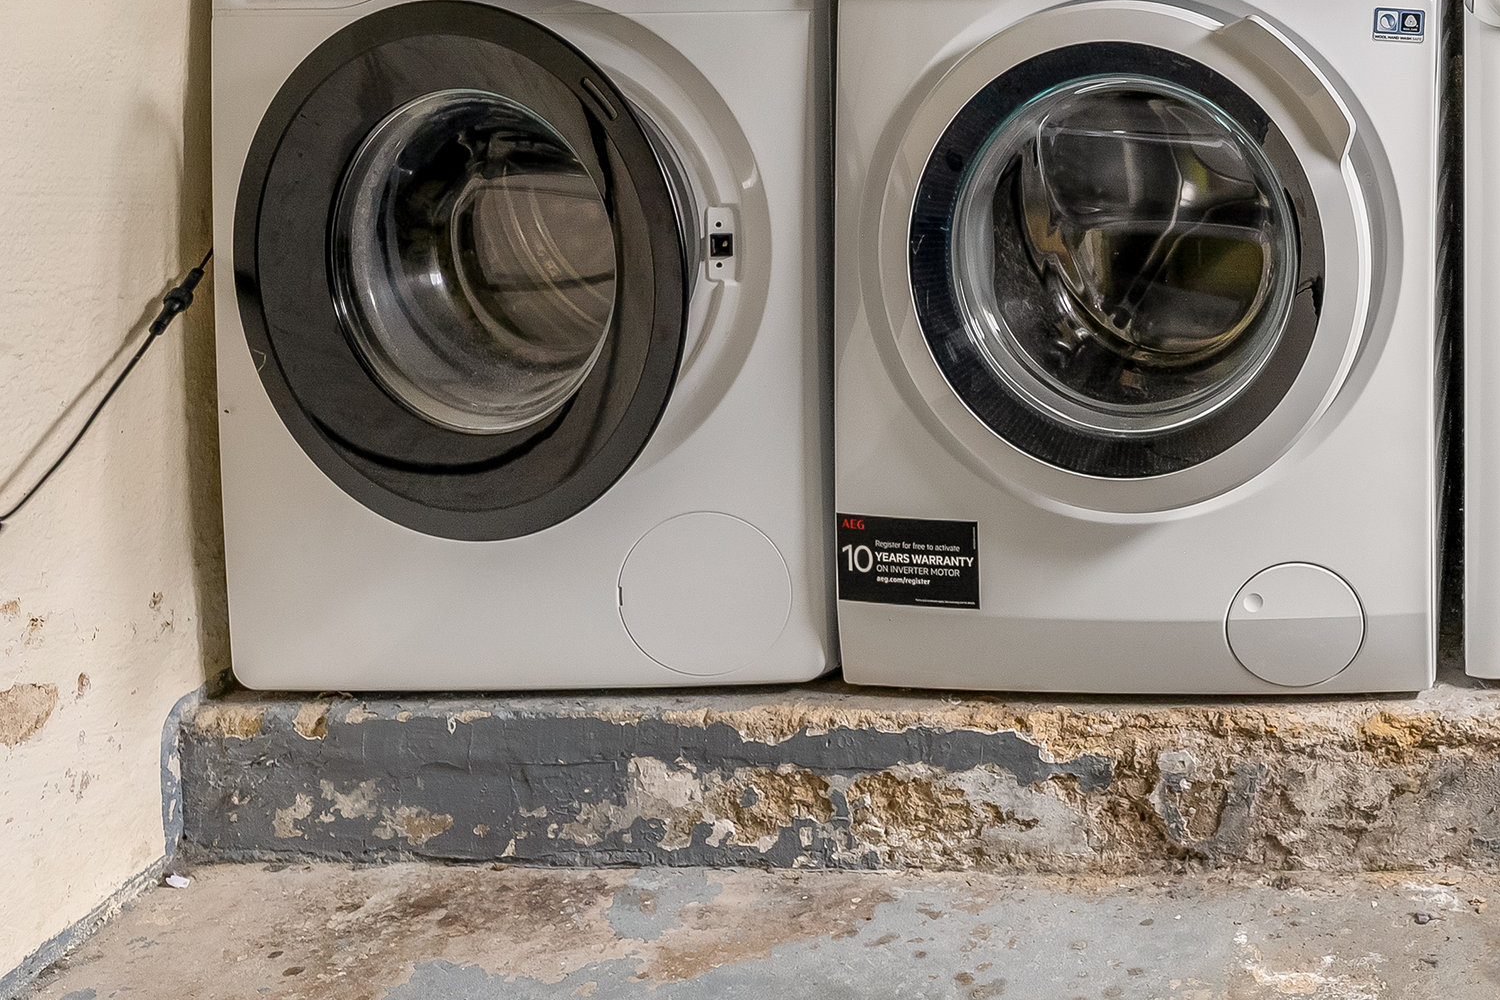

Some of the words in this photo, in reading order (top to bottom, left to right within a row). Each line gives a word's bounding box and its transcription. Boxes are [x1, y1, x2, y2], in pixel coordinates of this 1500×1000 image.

[842, 518, 865, 530] AEG
[875, 539, 901, 549] Register
[902, 541, 911, 549] for
[912, 542, 925, 551] free
[935, 544, 960, 552] activate
[842, 544, 873, 573] 10
[875, 551, 910, 564] YEARS
[911, 554, 974, 567] WARRANTY
[876, 565, 889, 573] ON
[890, 565, 929, 576] INVERTER
[930, 568, 960, 577] MOTOR
[876, 576, 930, 586] aeg.com/register
